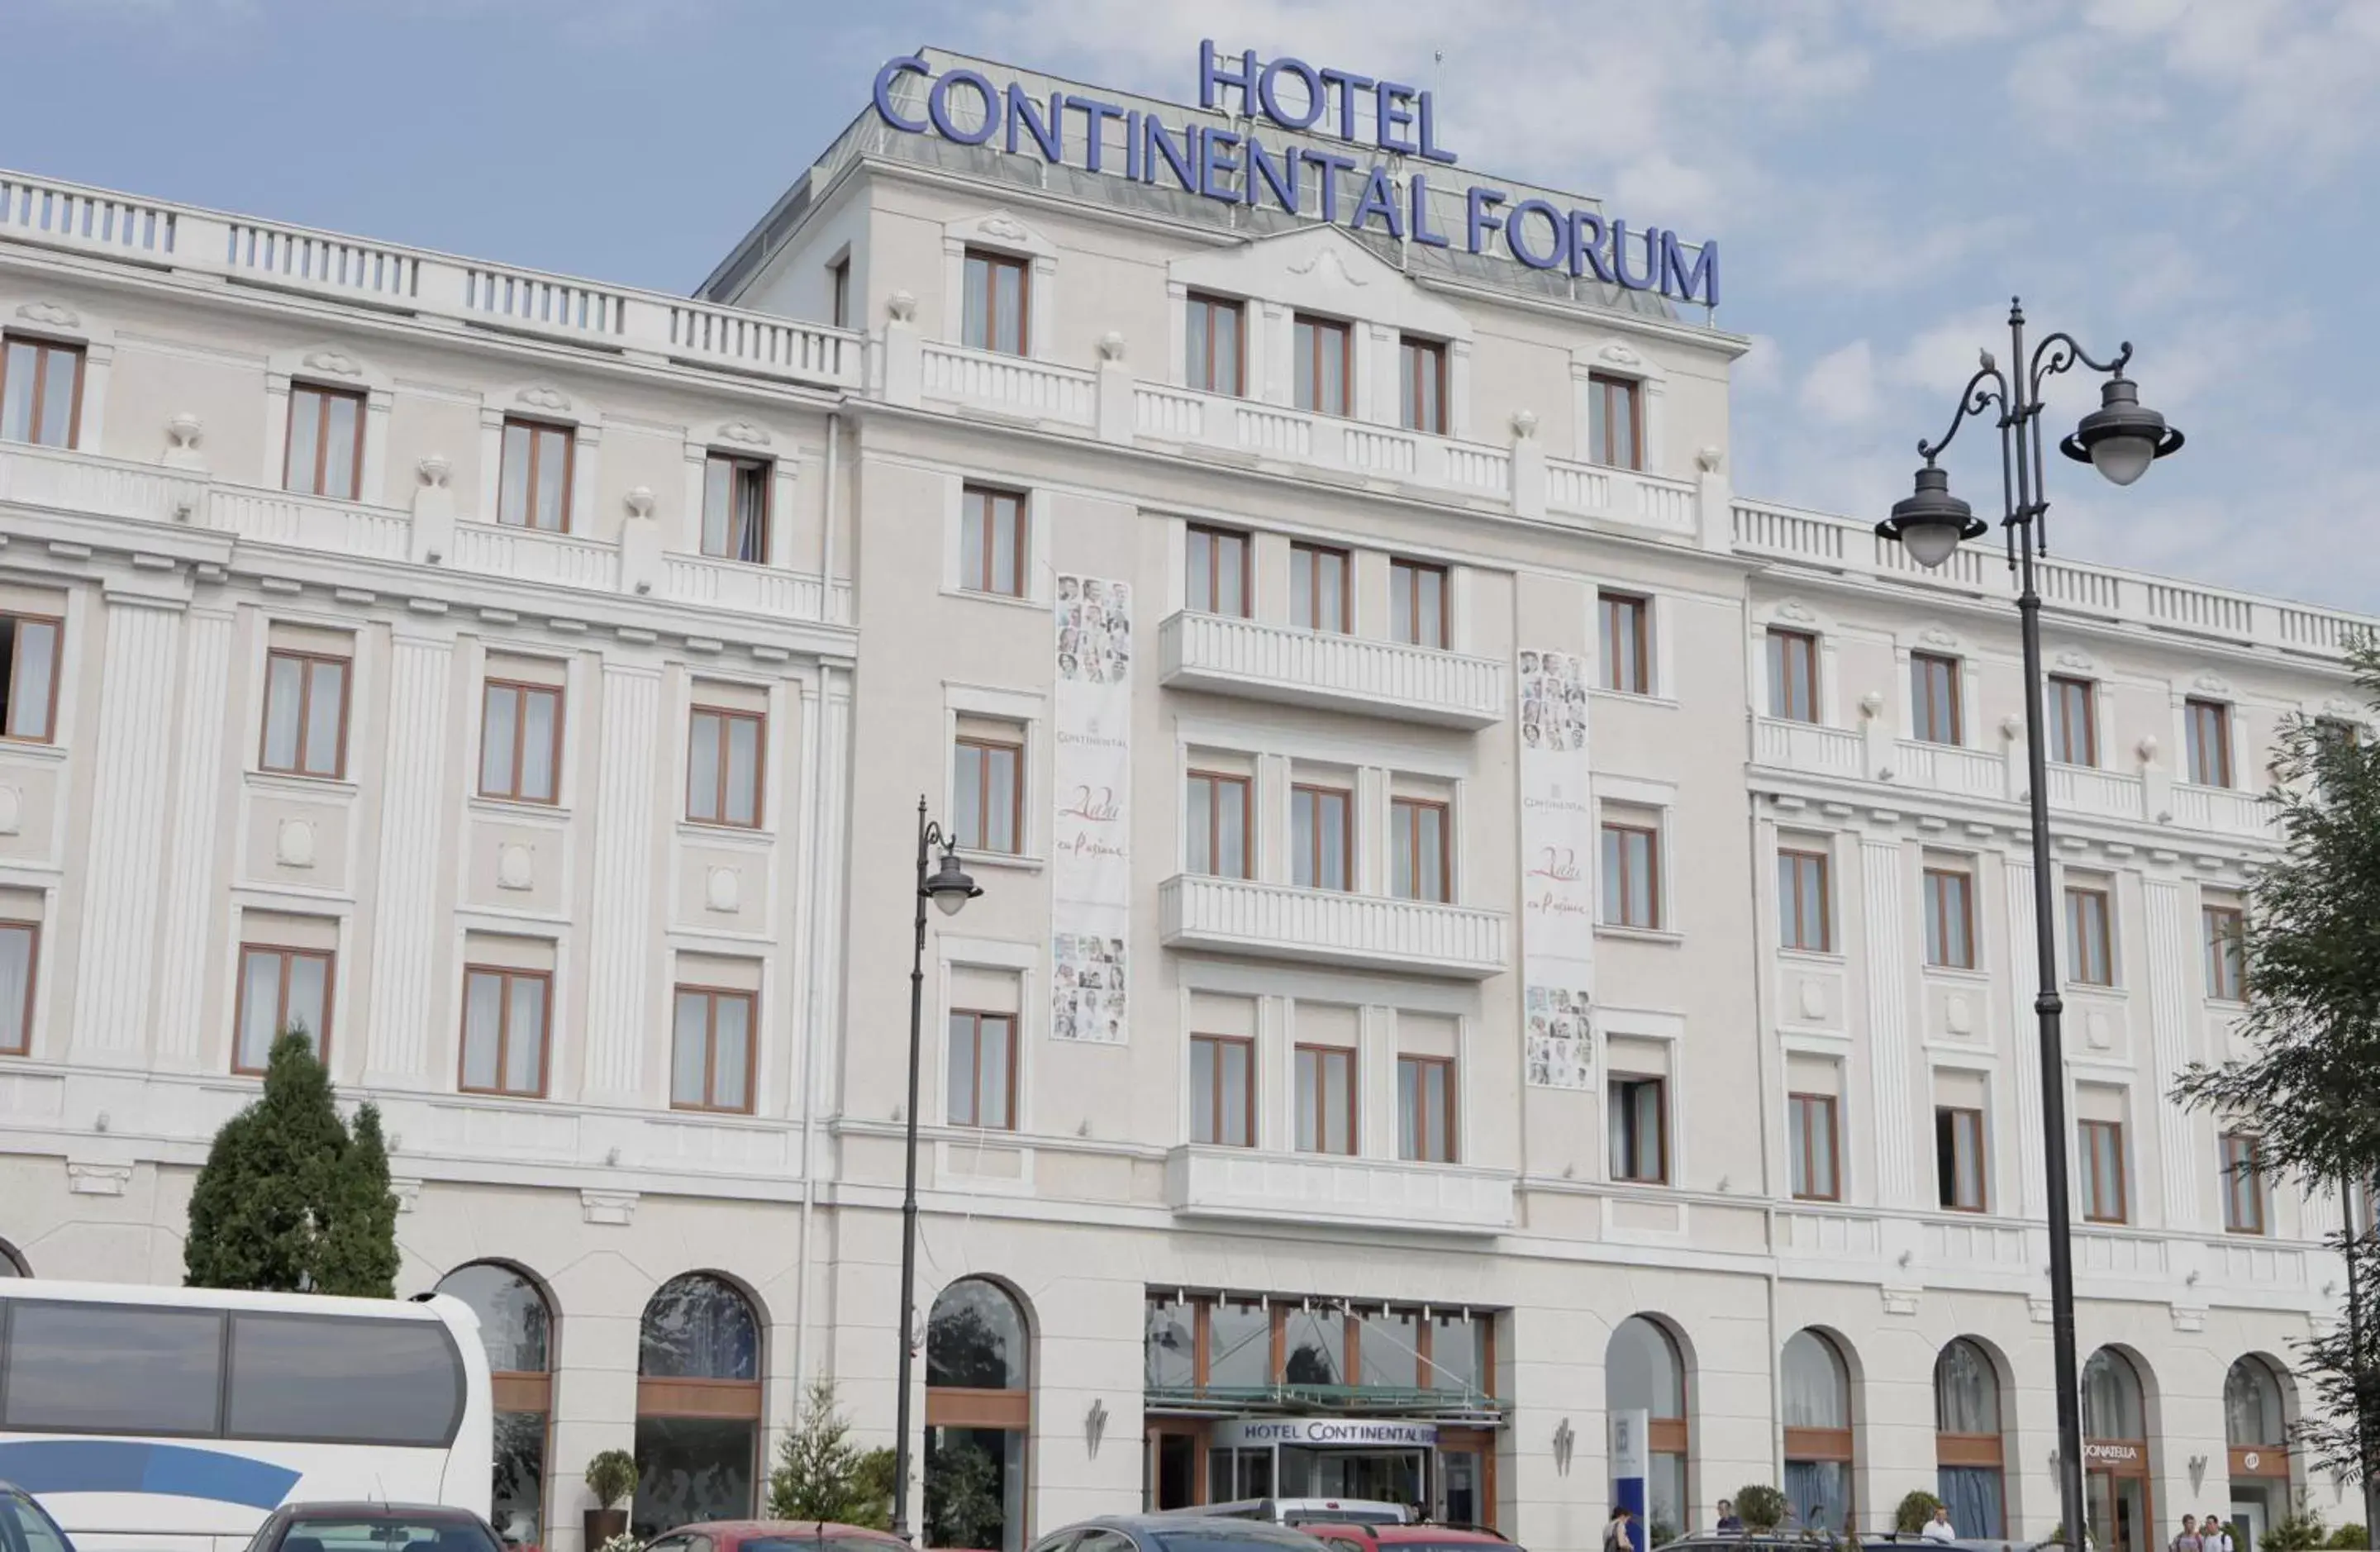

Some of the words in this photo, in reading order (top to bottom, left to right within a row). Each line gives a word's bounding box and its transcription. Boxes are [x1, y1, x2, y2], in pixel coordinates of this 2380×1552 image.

[1199, 39, 1458, 164] HOTEL
[873, 55, 1449, 248] CONTINENTAL
[1467, 186, 1719, 307] FORUM
[1245, 1424, 1301, 1440] HOTEL
[1307, 1421, 1416, 1441] CONTINENTAL
